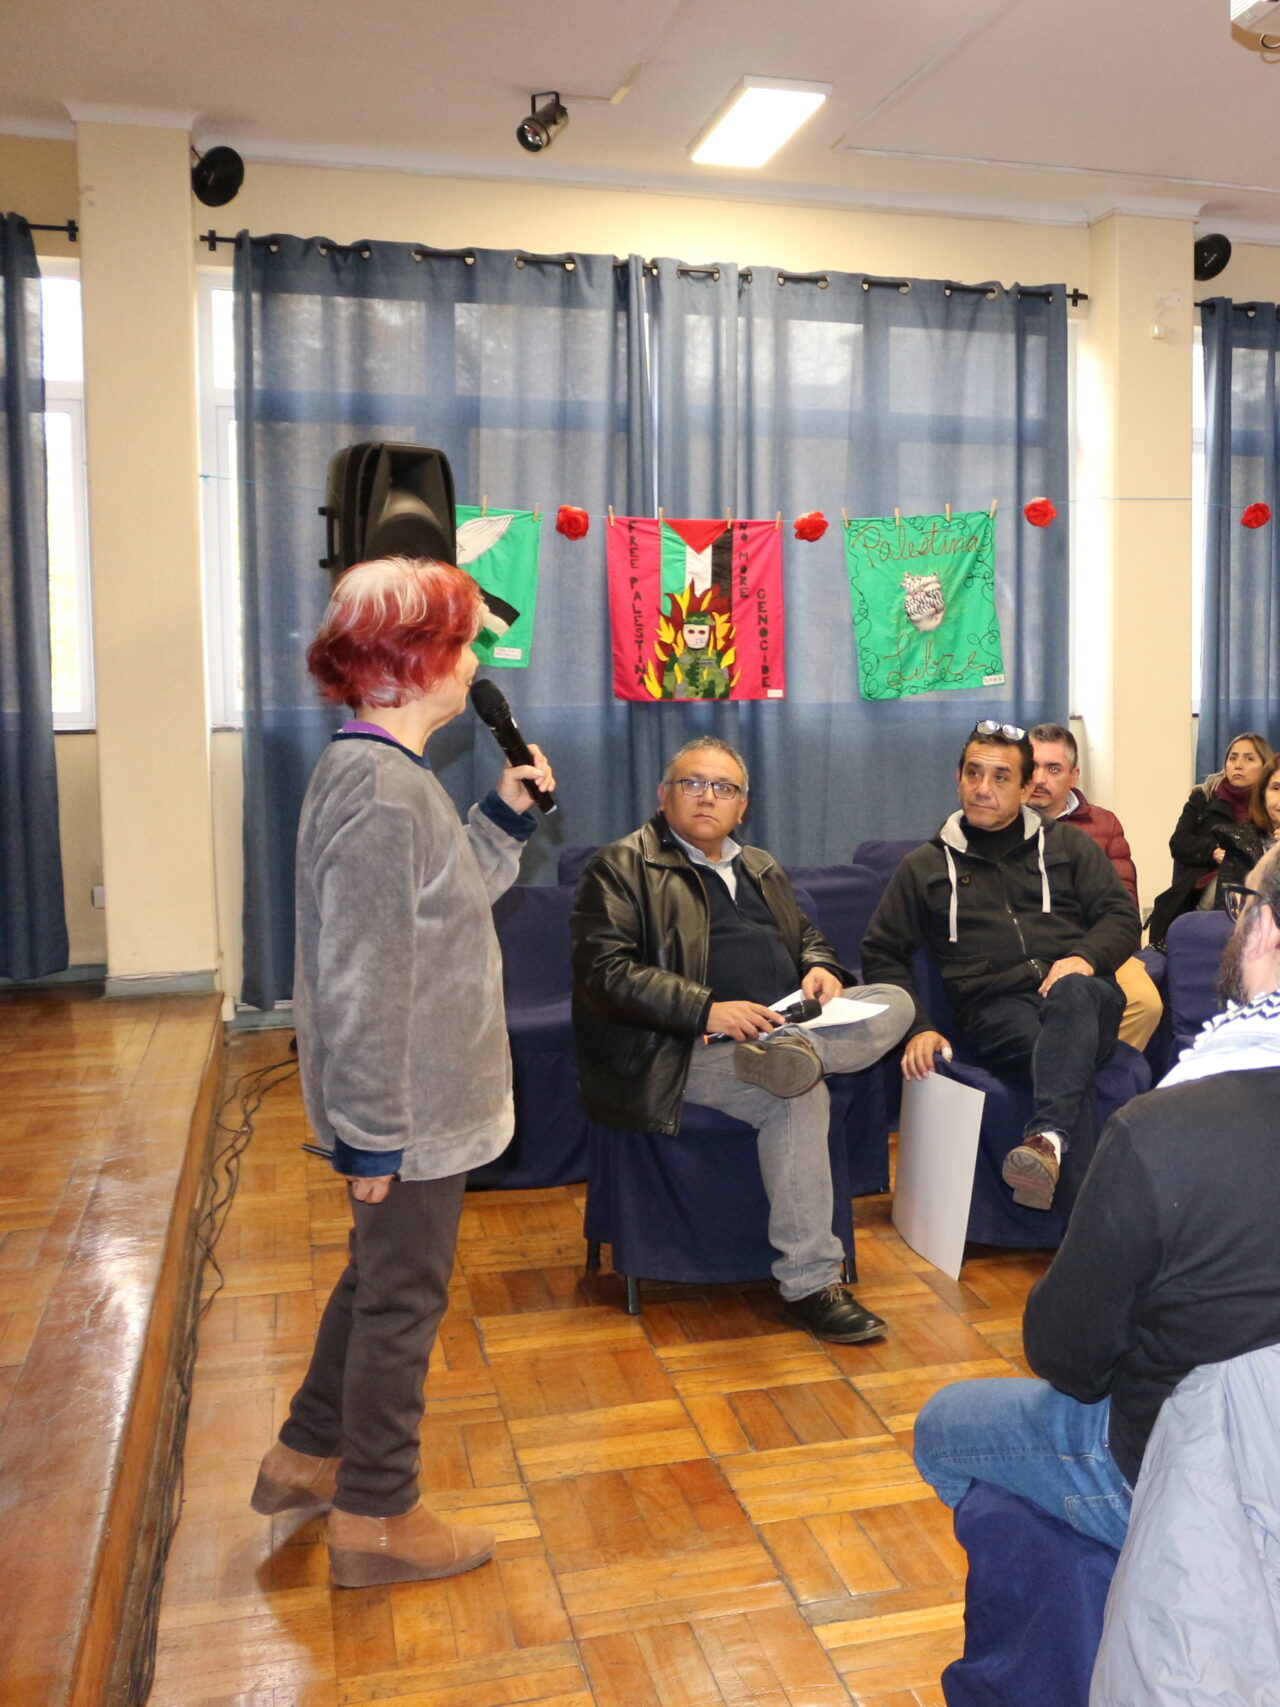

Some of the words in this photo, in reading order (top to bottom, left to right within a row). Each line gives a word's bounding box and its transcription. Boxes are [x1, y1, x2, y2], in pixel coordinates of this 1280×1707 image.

[628, 520, 640, 569] FREE
[738, 523, 749, 542] NO
[738, 552, 750, 599] MORE
[630, 576, 647, 687] PALESTINA
[756, 588, 771, 688] GENOCIDE
